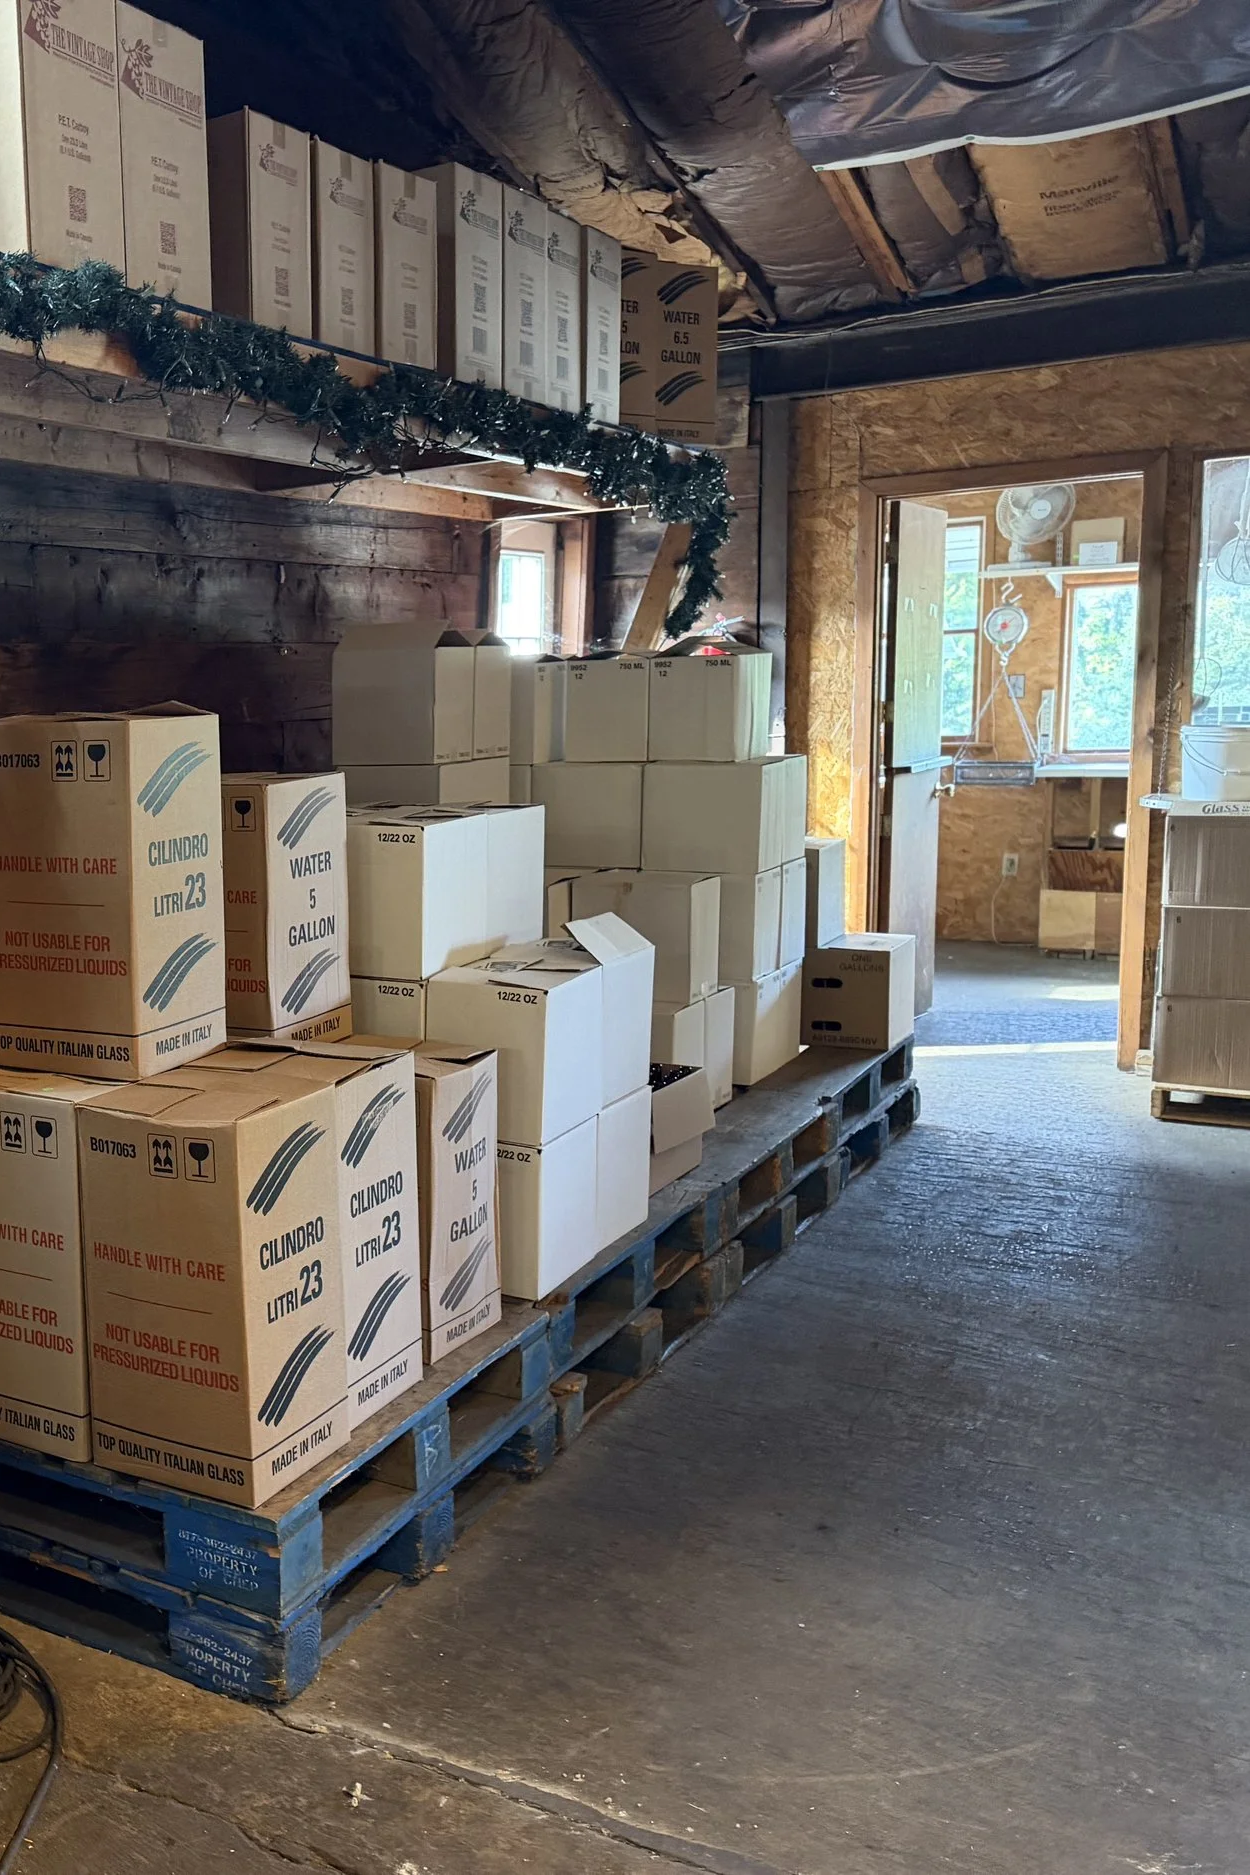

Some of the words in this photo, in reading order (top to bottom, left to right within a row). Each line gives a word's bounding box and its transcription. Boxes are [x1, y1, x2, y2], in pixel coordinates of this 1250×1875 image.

[50, 24, 66, 50] THE
[66, 30, 96, 64] VINTAGE
[97, 46, 114, 72] SHOP
[144, 71, 158, 96] THE
[663, 310, 700, 325] WATER
[673, 332, 689, 344] 6.5
[661, 350, 700, 364] GALLON
[1202, 804, 1240, 814] Glass
[148, 833, 209, 868] CILINDRO
[378, 832, 400, 843] 12/22
[402, 834, 416, 844] OZ
[46, 856, 79, 875] WITH
[83, 858, 118, 875] CARE
[290, 850, 332, 880] WATER
[154, 891, 184, 918] LITRI
[184, 872, 207, 911] 23
[226, 890, 258, 905] CARE
[309, 888, 317, 910] 5
[4, 931, 30, 949] NOT
[33, 934, 81, 952] USABLE
[84, 936, 110, 953] FOR
[288, 914, 336, 947] GALLON
[76, 956, 128, 976] LIQUIDS
[228, 958, 252, 972] FOR
[378, 984, 400, 996] 12/22
[402, 988, 414, 998] OZ
[497, 991, 521, 1003] 12/22
[523, 994, 538, 1005] OZ
[156, 1037, 181, 1056] MADE
[182, 1035, 190, 1048] IN
[192, 1023, 212, 1046] ITALY
[314, 1024, 322, 1037] IN
[322, 1016, 341, 1035] ITALY
[15, 1036, 55, 1054] QUALITY
[56, 1040, 94, 1059] ITALIAN
[96, 1045, 130, 1062] GLASS
[90, 1136, 136, 1158] B017063
[454, 1136, 488, 1174] WATER
[516, 1152, 532, 1163] OZ
[350, 1170, 403, 1220] CILINDRO
[472, 1178, 478, 1200] 5
[450, 1200, 488, 1243] GALLON
[32, 1228, 64, 1252] CARE
[259, 1216, 324, 1271] CILINDRO
[355, 1236, 381, 1268] LITRI
[382, 1210, 402, 1253] 23
[93, 1241, 145, 1269] HANDLE
[145, 1252, 182, 1275] WITH
[187, 1260, 226, 1282] CARE
[267, 1288, 298, 1324] LITRI
[299, 1259, 323, 1306] 23
[32, 1306, 58, 1327] FOR
[446, 1319, 468, 1344] MADE
[468, 1313, 478, 1331] IN
[478, 1303, 491, 1326] ITALY
[24, 1326, 74, 1355] LIQUIDS
[105, 1323, 131, 1345] NOT
[133, 1328, 187, 1358] USABLE
[190, 1343, 220, 1364] FOR
[93, 1344, 179, 1380] PRESSURIZED
[181, 1364, 240, 1393] LIQUIDS
[357, 1380, 380, 1407] MADE
[380, 1372, 389, 1390] IN
[390, 1358, 409, 1384] ITALY
[4, 1406, 41, 1432] ITALIAN
[44, 1418, 76, 1442] GLASS
[96, 1431, 116, 1450] TOP
[118, 1437, 161, 1465] QUALITY
[162, 1450, 205, 1476] ITALIAN
[208, 1462, 246, 1486] GLASS
[271, 1450, 298, 1476] MADE
[299, 1440, 310, 1460] IN
[310, 1420, 333, 1452] ITALY
[186, 1546, 258, 1576] PROPERTY
[198, 1566, 216, 1580] OF
